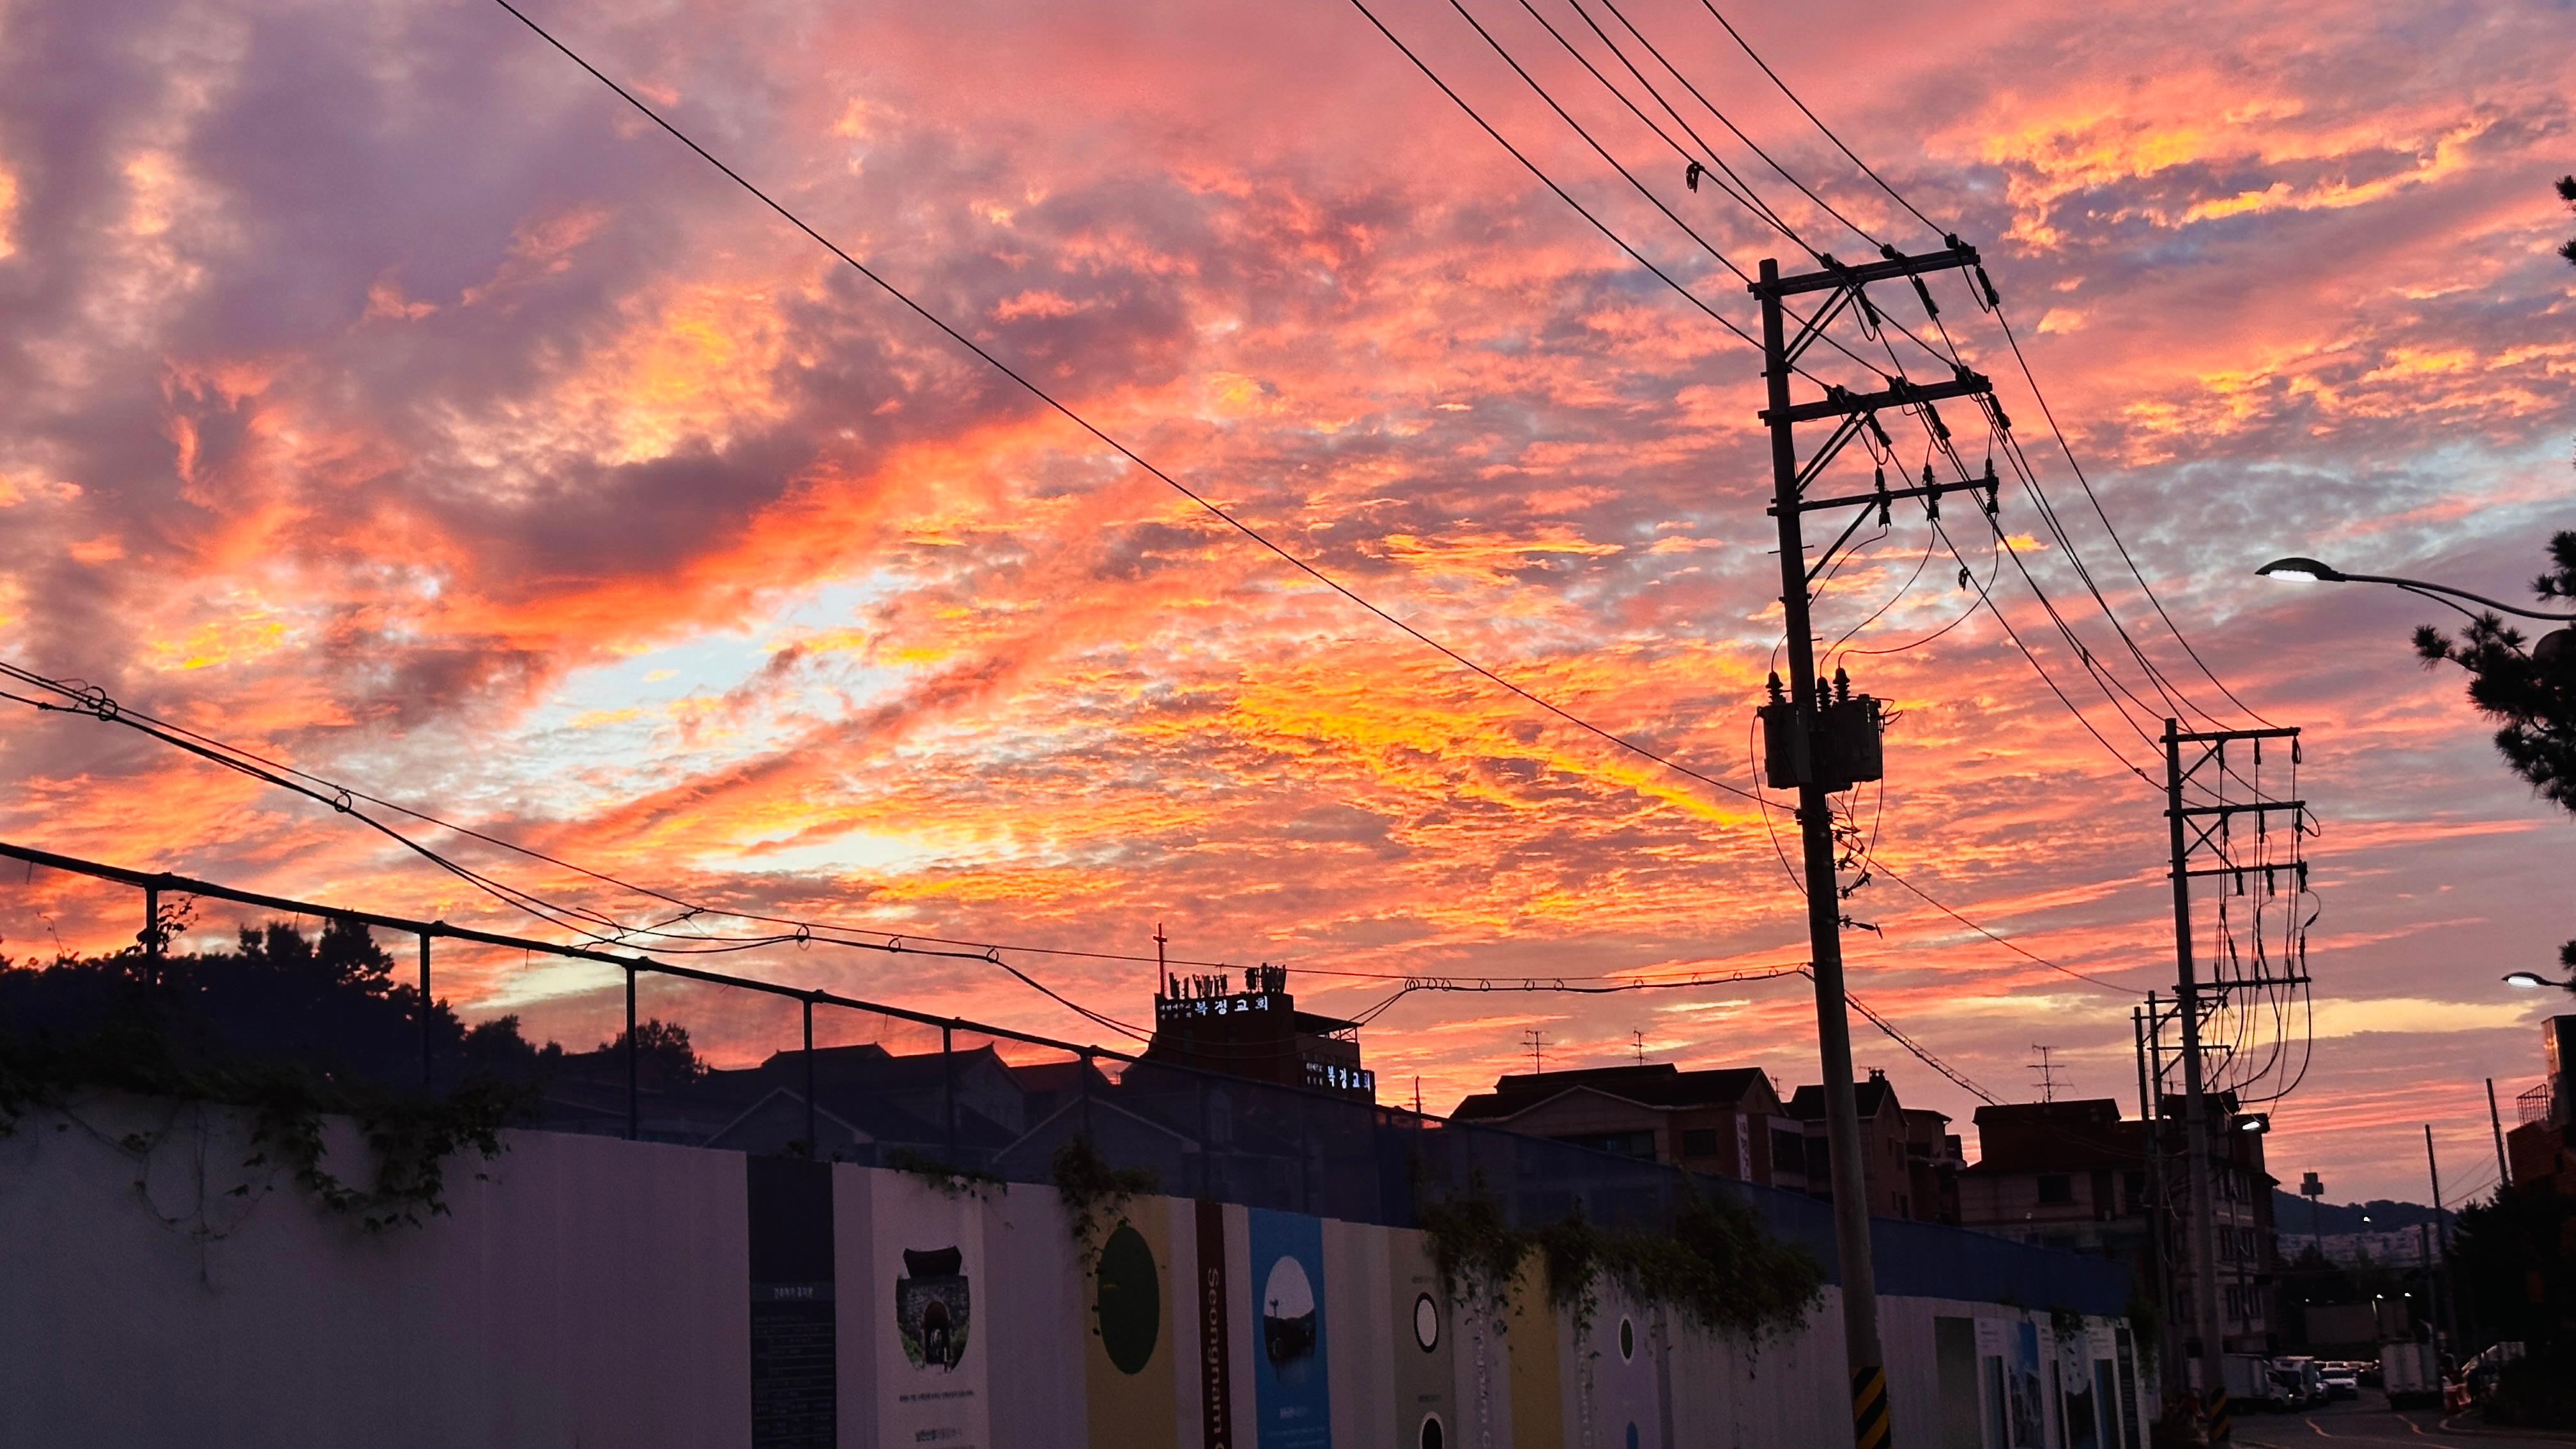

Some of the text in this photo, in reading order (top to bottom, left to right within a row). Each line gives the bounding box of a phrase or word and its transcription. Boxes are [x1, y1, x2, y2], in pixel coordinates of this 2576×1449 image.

[1194, 995, 1268, 1016] 복정교회
[1327, 1065, 1370, 1092] 복정교회
[1207, 1268, 1222, 1434] Seongnam
